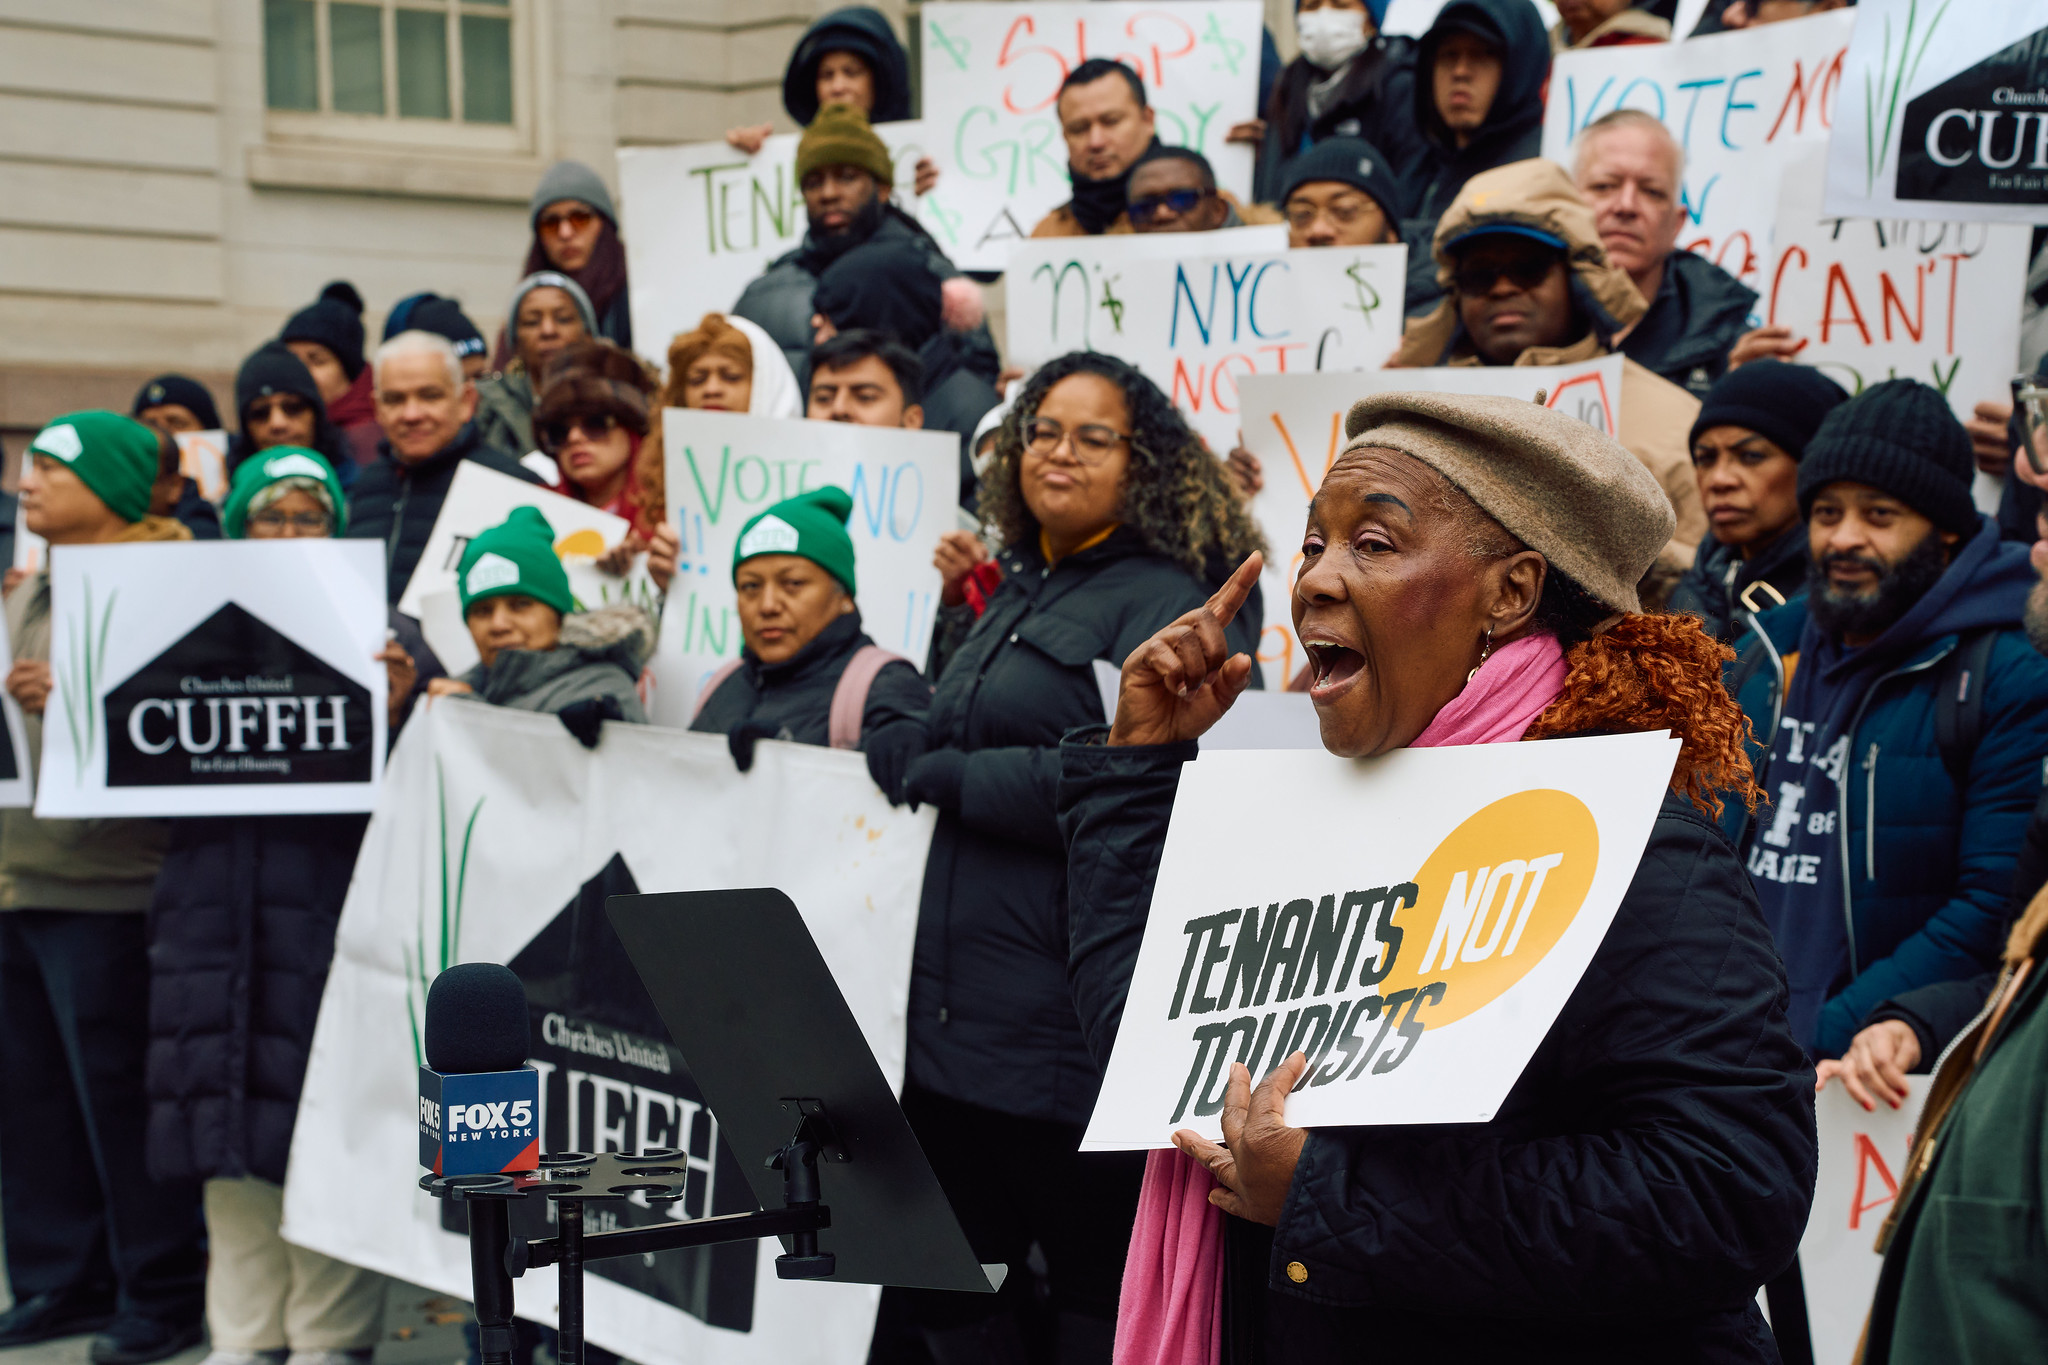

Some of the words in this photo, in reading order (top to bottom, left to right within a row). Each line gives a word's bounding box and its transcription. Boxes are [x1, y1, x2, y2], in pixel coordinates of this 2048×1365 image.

[1168, 258, 1293, 350] NYC
[843, 460, 924, 543] NO
[127, 695, 351, 755] CUFFH
[1168, 881, 1419, 1021] TENANTS
[1418, 853, 1564, 976] NOT
[612, 1031, 671, 1075] United
[448, 1132, 482, 1143] NEW
[490, 1127, 532, 1139] YORK
